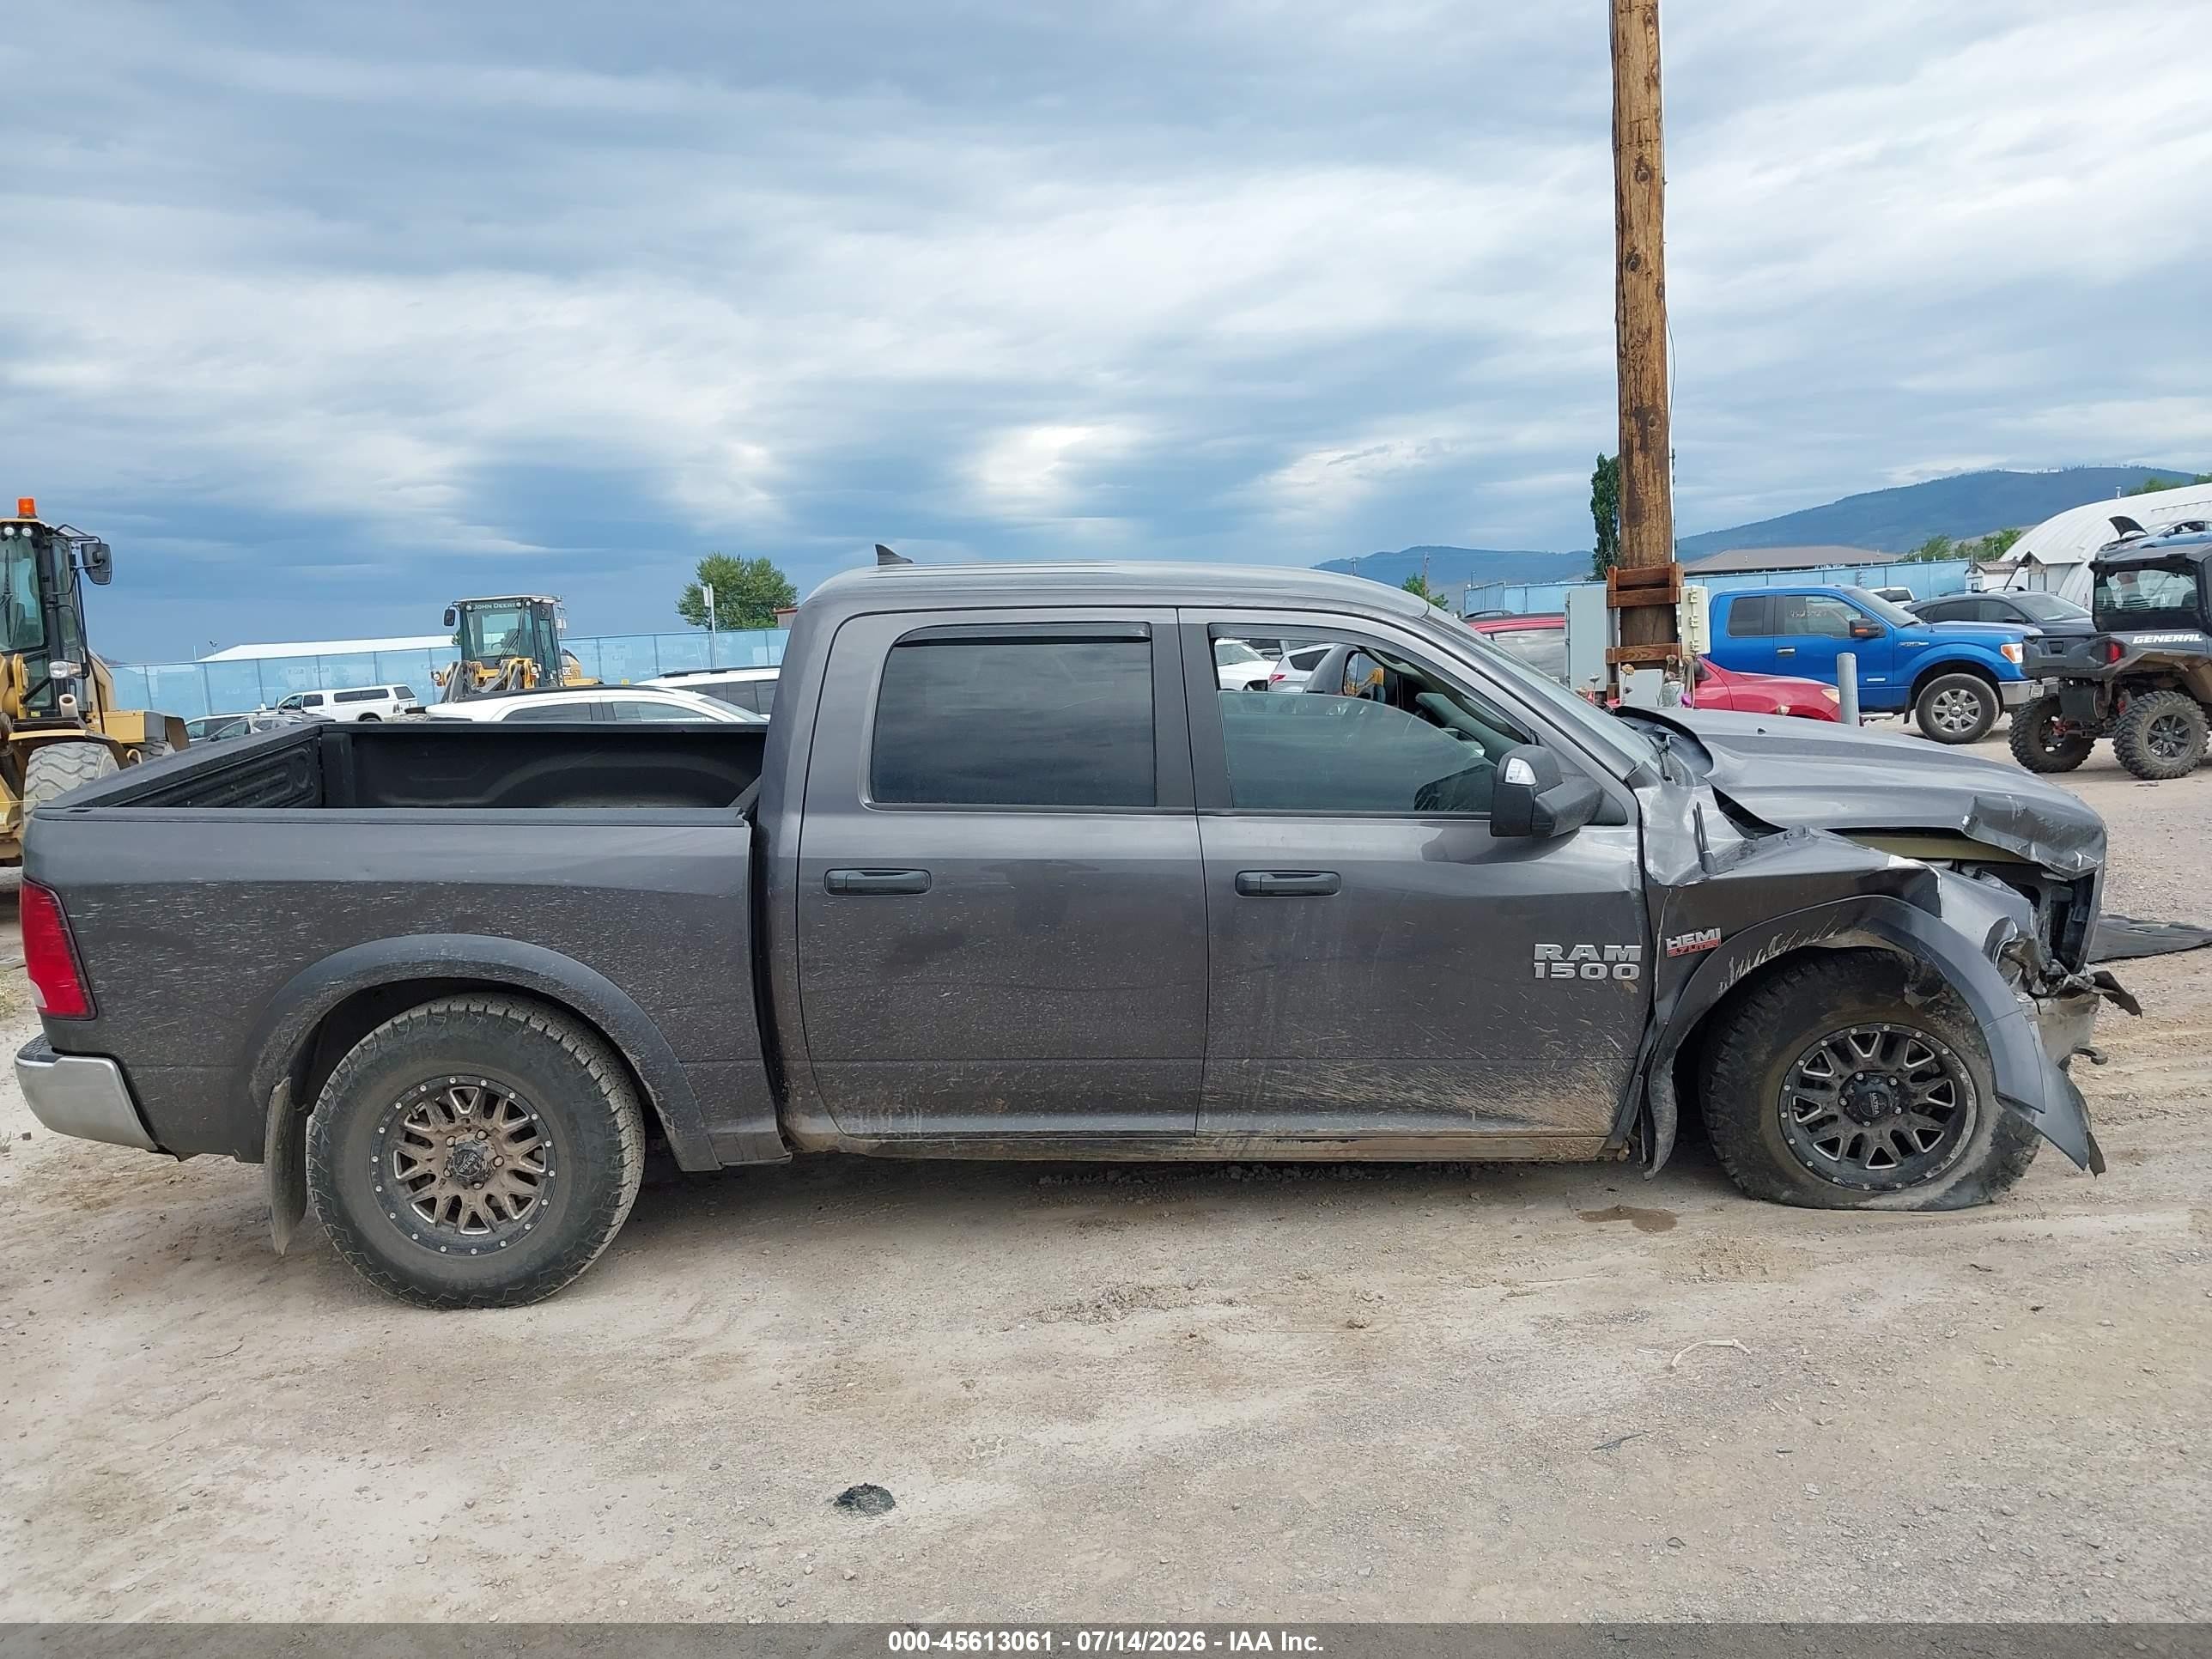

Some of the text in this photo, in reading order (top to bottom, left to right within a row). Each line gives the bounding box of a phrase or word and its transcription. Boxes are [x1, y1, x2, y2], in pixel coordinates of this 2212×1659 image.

[2132, 634, 2203, 644] GENERAL
[1665, 927, 1722, 950] HEMI
[1534, 943, 1643, 962] RAM
[1533, 962, 1641, 981] 1500
[1871, 1092, 1880, 1115] ULTRA
